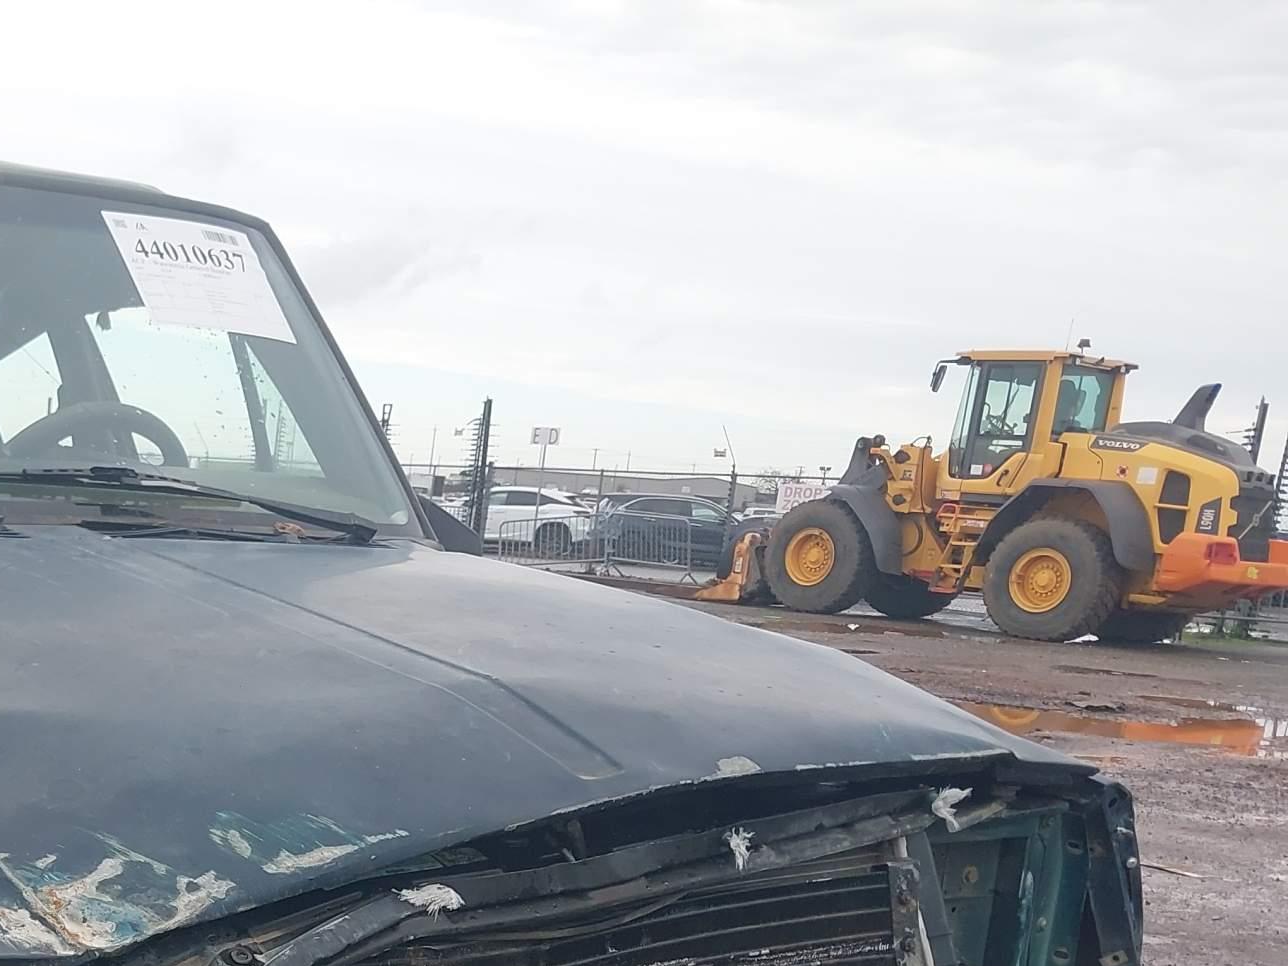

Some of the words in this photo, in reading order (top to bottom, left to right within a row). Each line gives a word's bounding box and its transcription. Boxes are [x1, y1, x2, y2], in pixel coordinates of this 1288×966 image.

[135, 238, 245, 273] 44010637
[1098, 439, 1140, 450] VOLVO
[783, 486, 823, 499] DROP
[1199, 509, 1216, 530] L90H
